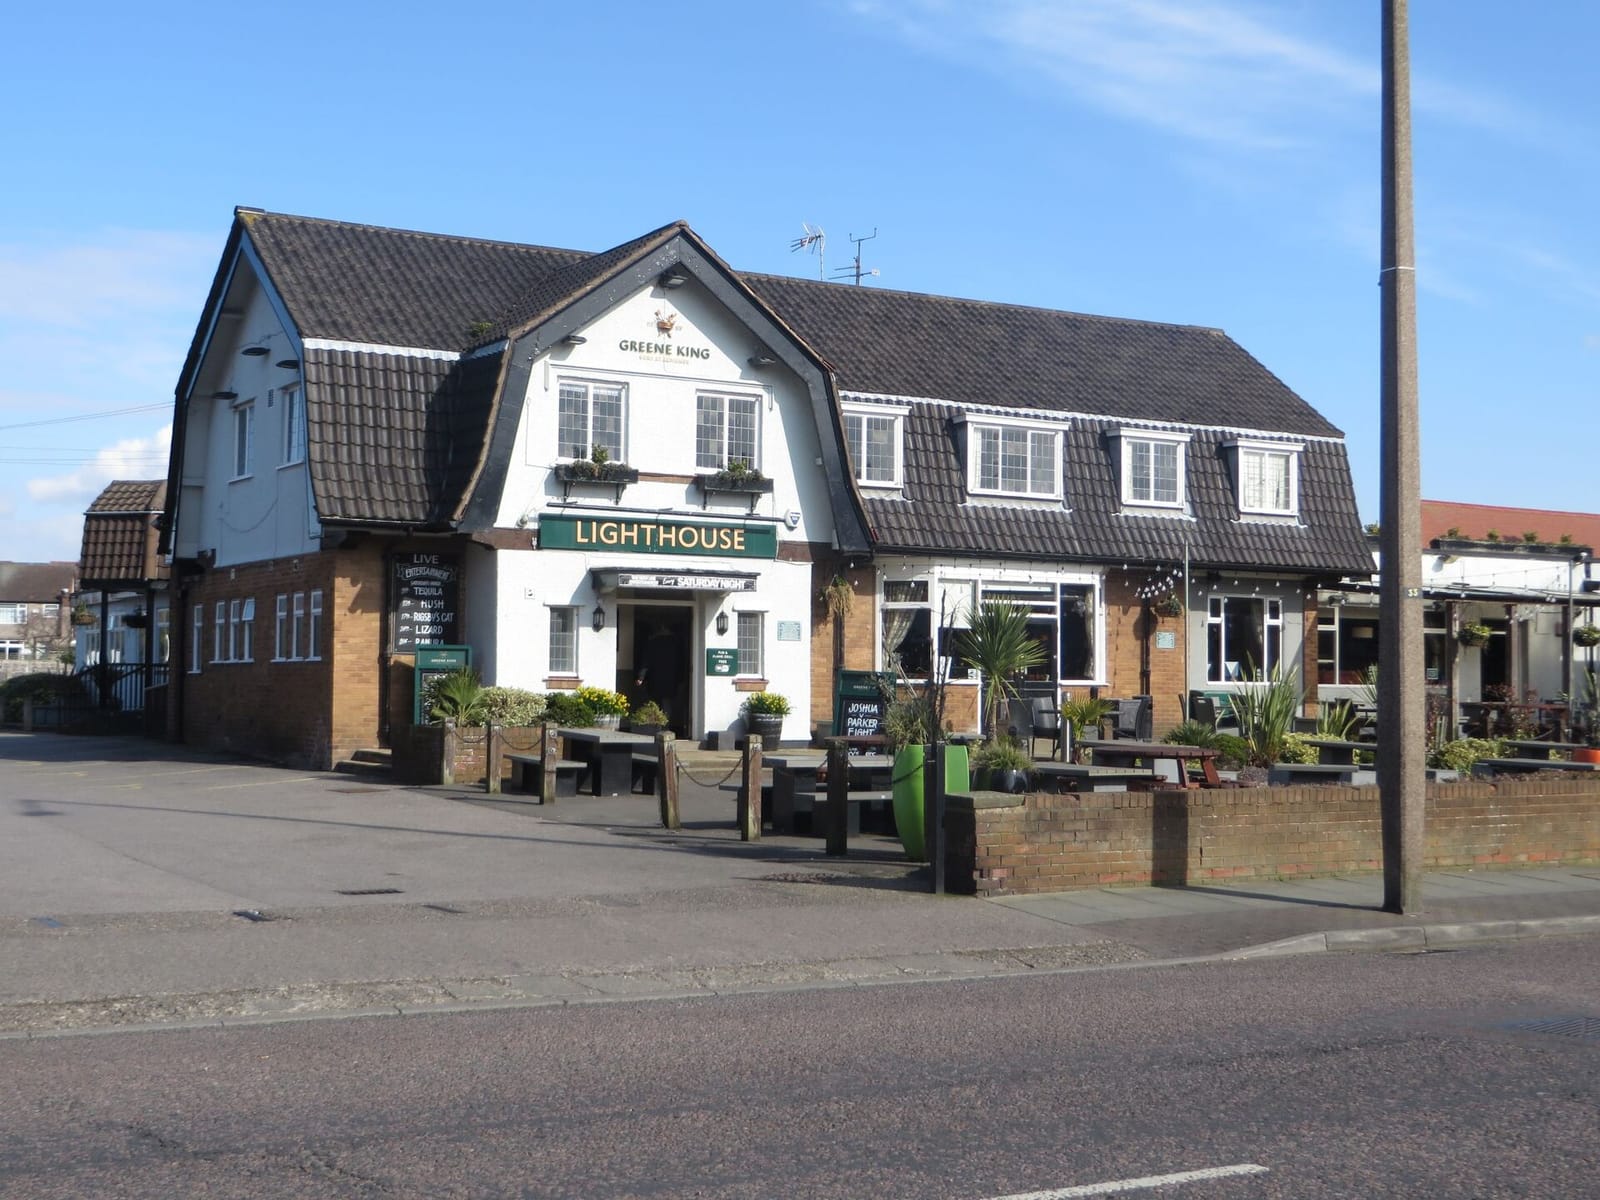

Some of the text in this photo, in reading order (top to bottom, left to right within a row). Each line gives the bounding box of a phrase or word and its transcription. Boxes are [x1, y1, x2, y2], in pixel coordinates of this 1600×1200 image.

[618, 339, 710, 360] GREENE KING
[575, 519, 746, 551] LIGHTHOUSE
[413, 553, 440, 564] LIVE
[405, 566, 450, 581] ENTERTAINMENT
[677, 577, 721, 589] SATURDAY
[720, 579, 746, 590] NIGHT
[413, 586, 443, 596] TEQUILA
[420, 599, 444, 609] HUSH
[441, 612, 454, 622] CAT
[415, 624, 443, 634] LIZARD
[848, 702, 879, 714] JOSHUA
[847, 717, 878, 729] PARKER
[848, 727, 875, 736] FIGHT
